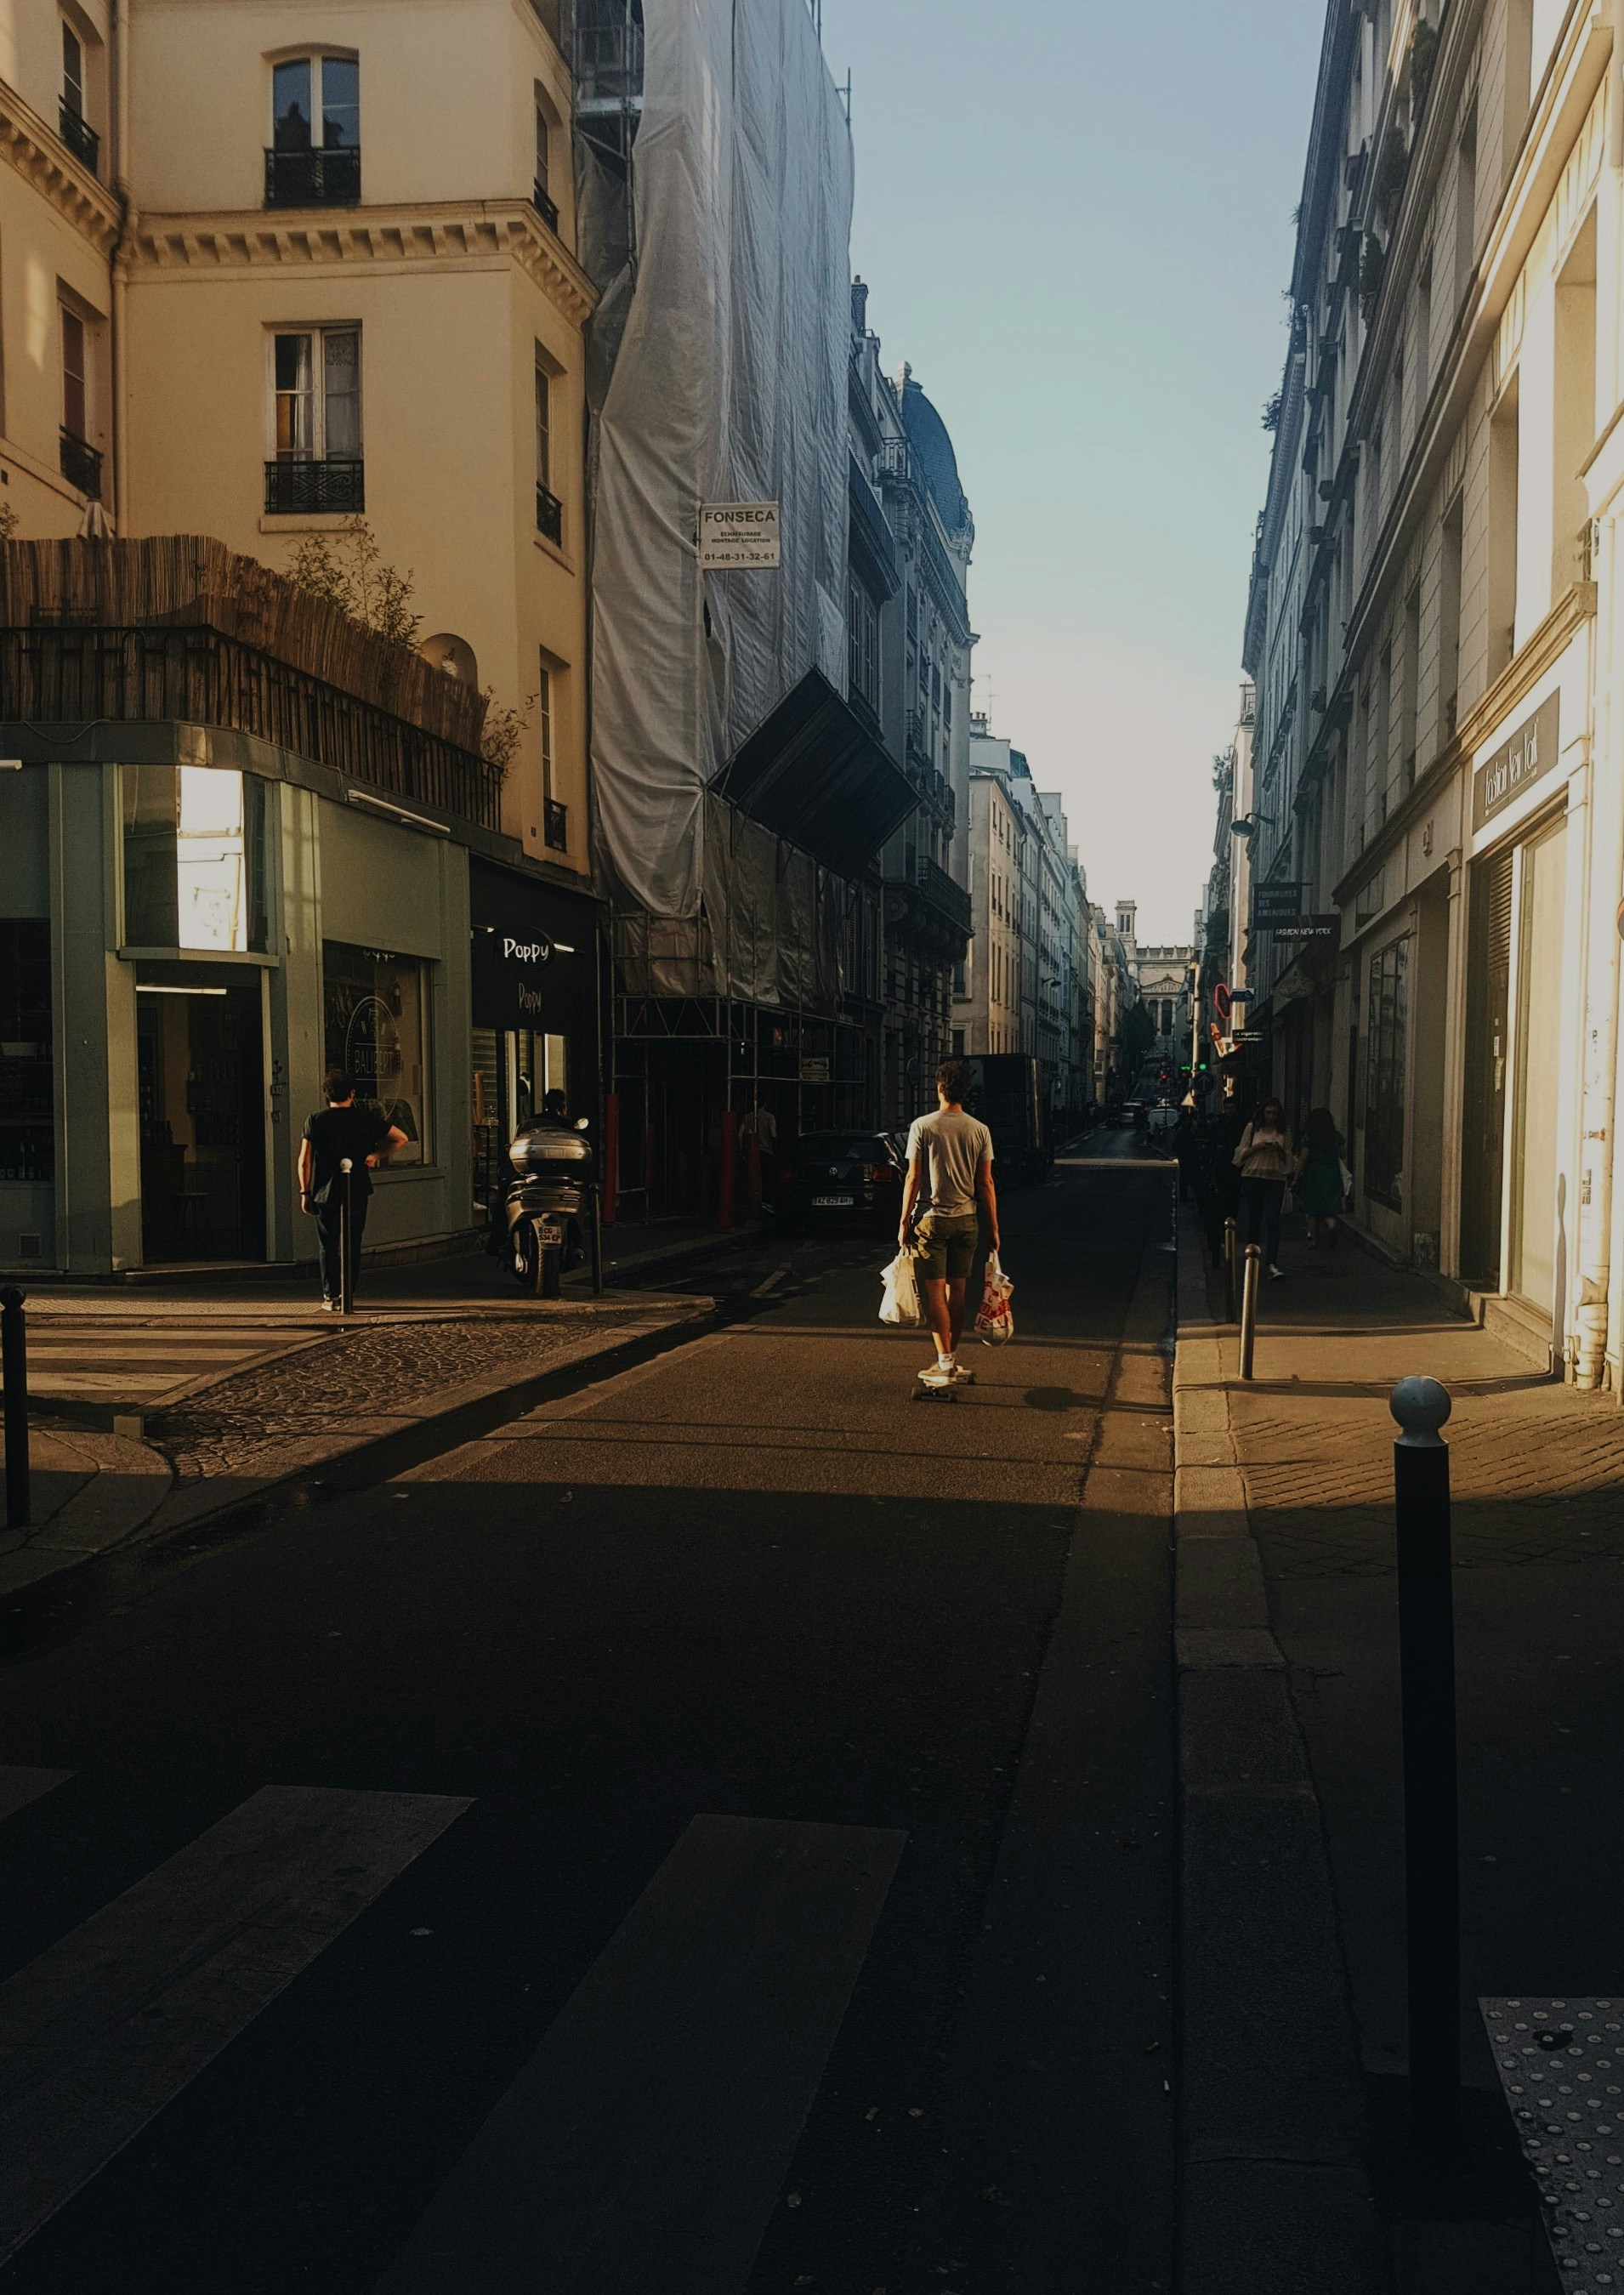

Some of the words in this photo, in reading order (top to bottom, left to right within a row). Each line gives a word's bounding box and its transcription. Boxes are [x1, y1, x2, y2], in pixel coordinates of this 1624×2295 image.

[705, 510, 775, 523] FONSECA
[704, 553, 775, 561] 01-48-31-32-61
[503, 938, 549, 963] Poppy
[519, 982, 542, 1015] Poppy
